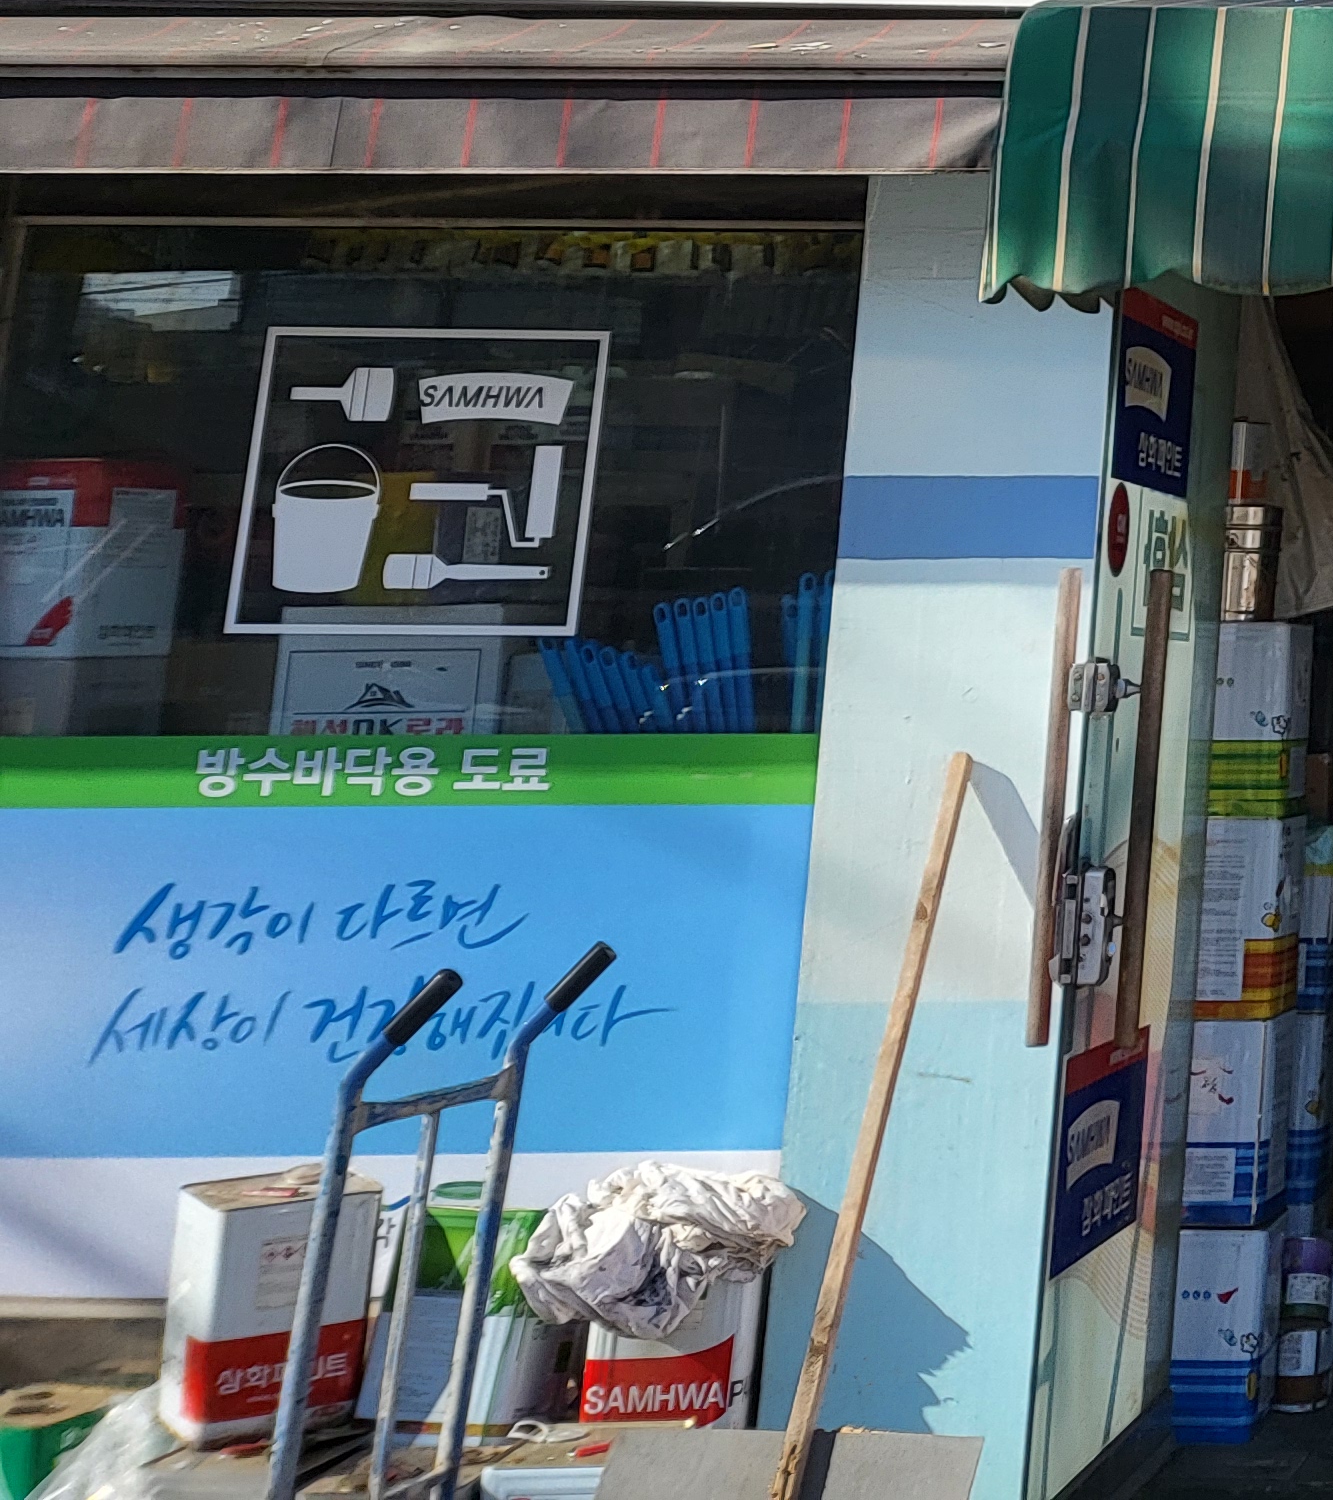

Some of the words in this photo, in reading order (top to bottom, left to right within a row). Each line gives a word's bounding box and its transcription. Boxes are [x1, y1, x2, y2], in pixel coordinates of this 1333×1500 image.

[420, 384, 545, 409] SAMHWA
[195, 746, 439, 797] 방수바닥용
[452, 747, 551, 791] 도료
[113, 882, 314, 960] 생각이
[335, 878, 531, 951] 다르면
[88, 985, 292, 1068] 세상이
[583, 1380, 725, 1416] SAMHWA
